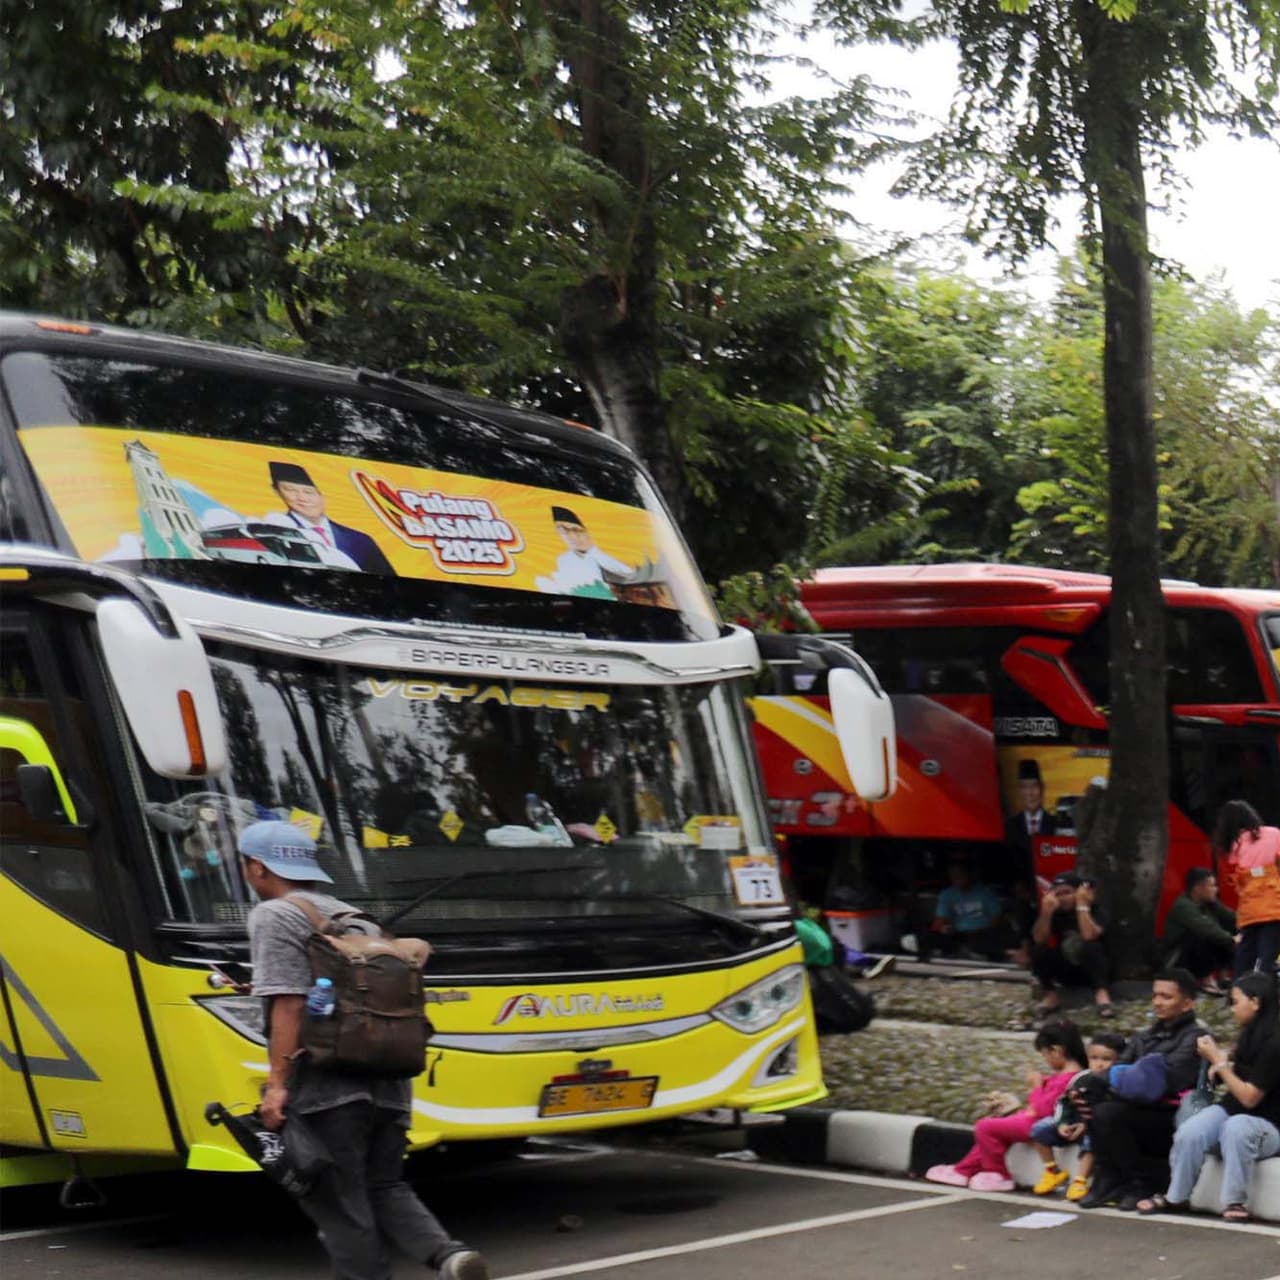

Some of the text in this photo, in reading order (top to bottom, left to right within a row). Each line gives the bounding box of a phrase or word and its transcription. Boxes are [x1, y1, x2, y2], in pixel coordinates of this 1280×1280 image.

[400, 490, 491, 520] Pulang
[435, 538, 505, 564] 2025
[366, 676, 611, 713] VOYAGER
